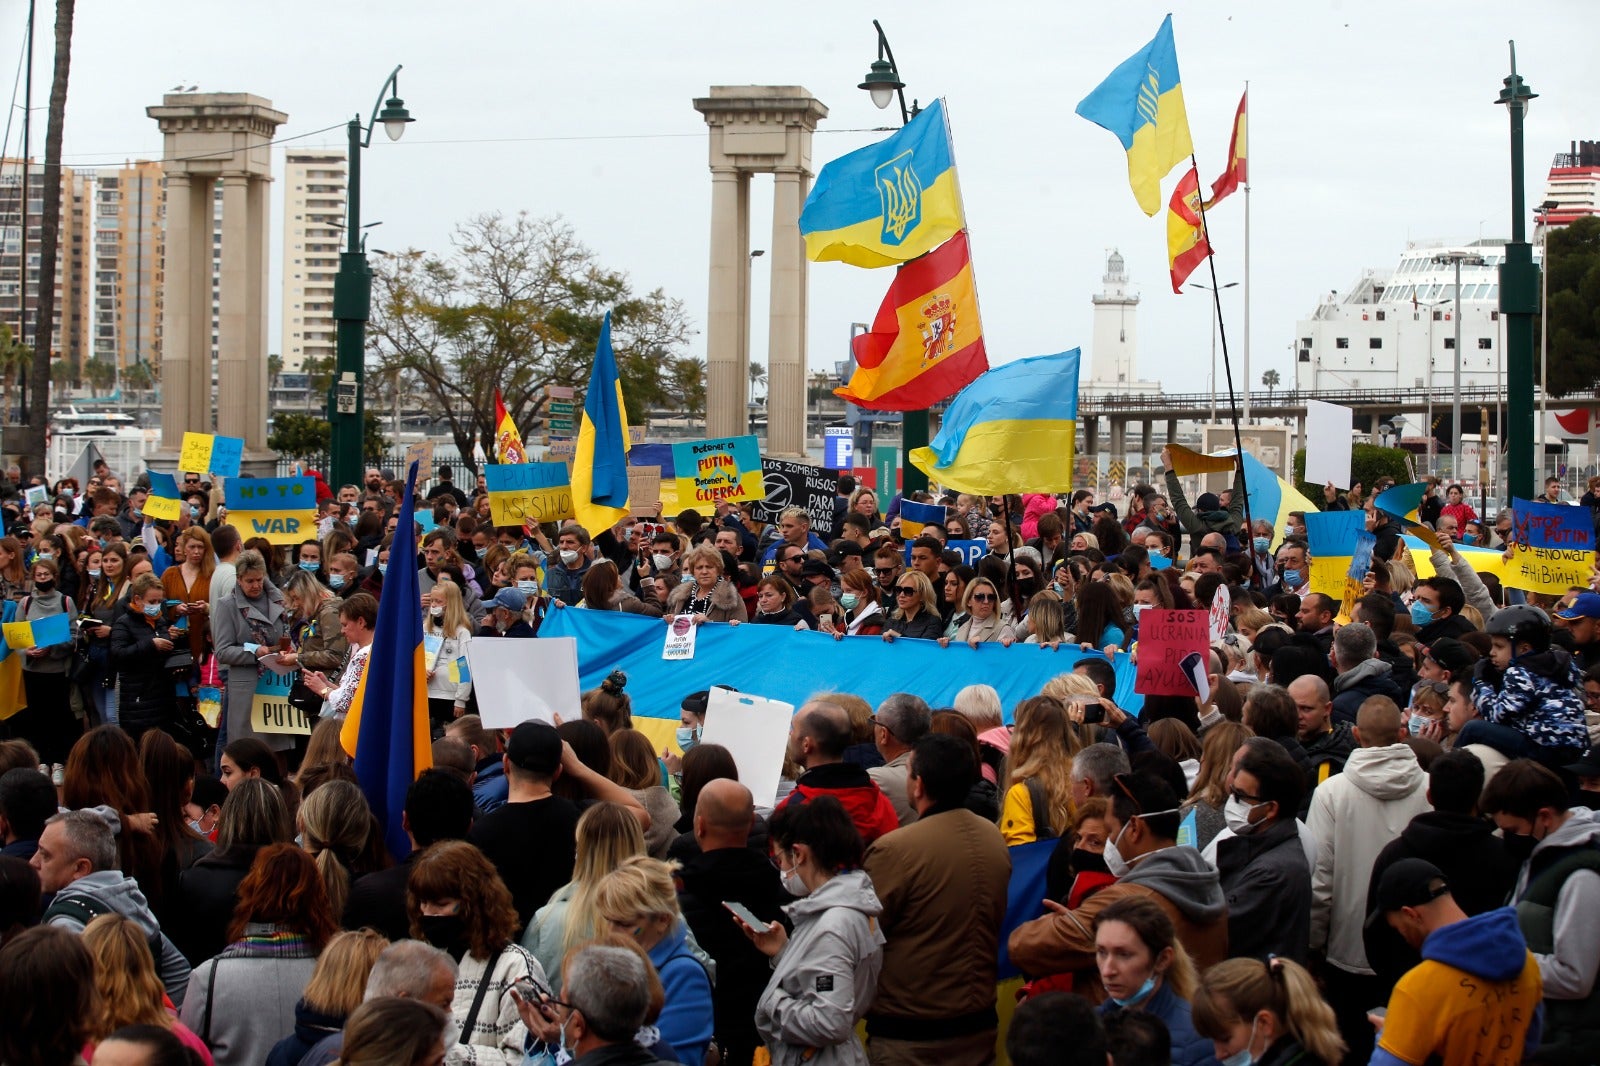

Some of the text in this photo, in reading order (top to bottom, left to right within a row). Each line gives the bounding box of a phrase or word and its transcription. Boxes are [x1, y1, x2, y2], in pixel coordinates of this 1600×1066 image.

[836, 438, 853, 466] P
[697, 455, 733, 471] PUTIN
[763, 460, 819, 477] LOS ZOMBIS
[503, 467, 556, 488] PUTIN
[805, 477, 837, 492] RUSOS
[240, 483, 304, 499] NO TO
[695, 484, 746, 501] GUERRA
[502, 493, 570, 521] ASESINO
[808, 493, 835, 511] PARA
[752, 508, 769, 521] LOS
[1531, 515, 1564, 529] STOP
[251, 518, 300, 534] WAR
[1544, 527, 1589, 544] PUTIN
[1150, 624, 1208, 642] UCRANIA
